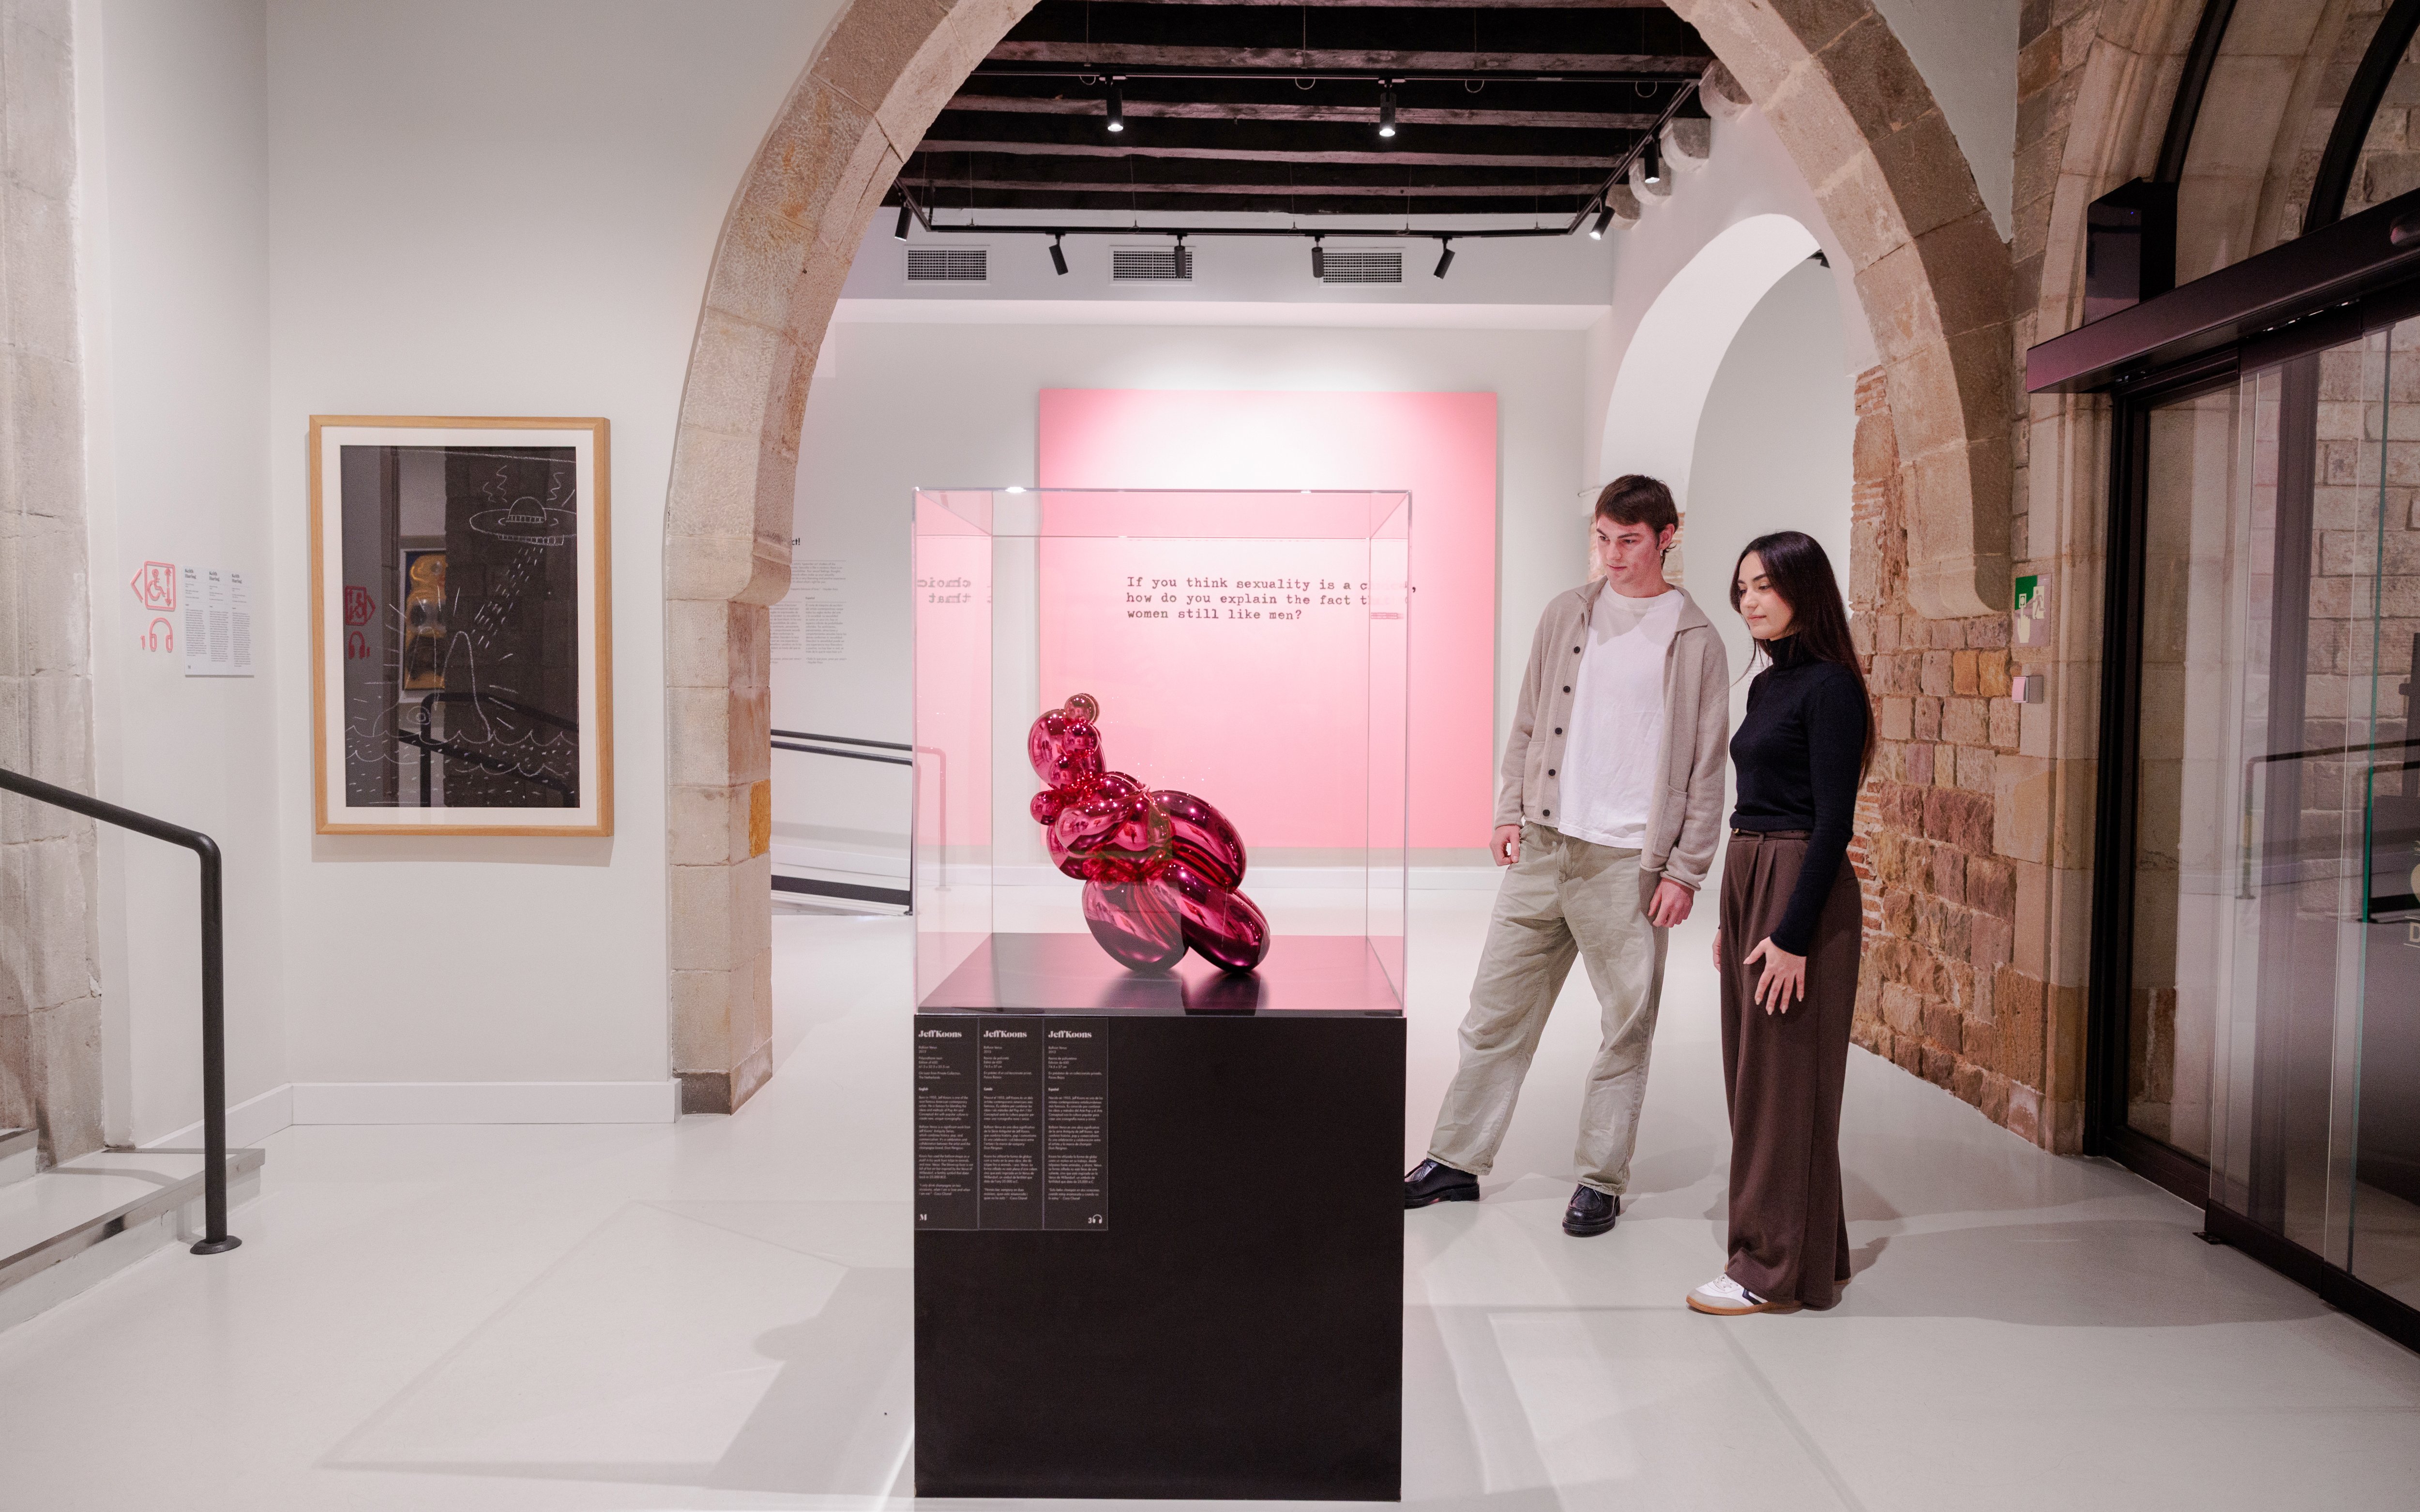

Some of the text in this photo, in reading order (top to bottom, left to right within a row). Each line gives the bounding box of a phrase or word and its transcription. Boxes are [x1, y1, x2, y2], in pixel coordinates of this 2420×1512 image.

[1127, 577, 1143, 587] If
[1152, 579, 1177, 589] you
[1186, 577, 1228, 587] think
[1236, 579, 1310, 591] sexuality
[1319, 579, 1335, 590] is
[1126, 592, 1152, 602] how
[1161, 592, 1177, 602] do
[1186, 595, 1211, 605] you
[1220, 593, 1277, 606] explain
[1286, 594, 1310, 604] the
[1320, 595, 1351, 605] fact
[1178, 608, 1219, 619] still
[1228, 609, 1260, 619] like
[1269, 609, 1302, 620] men?
[140, 635, 145, 648] 1
